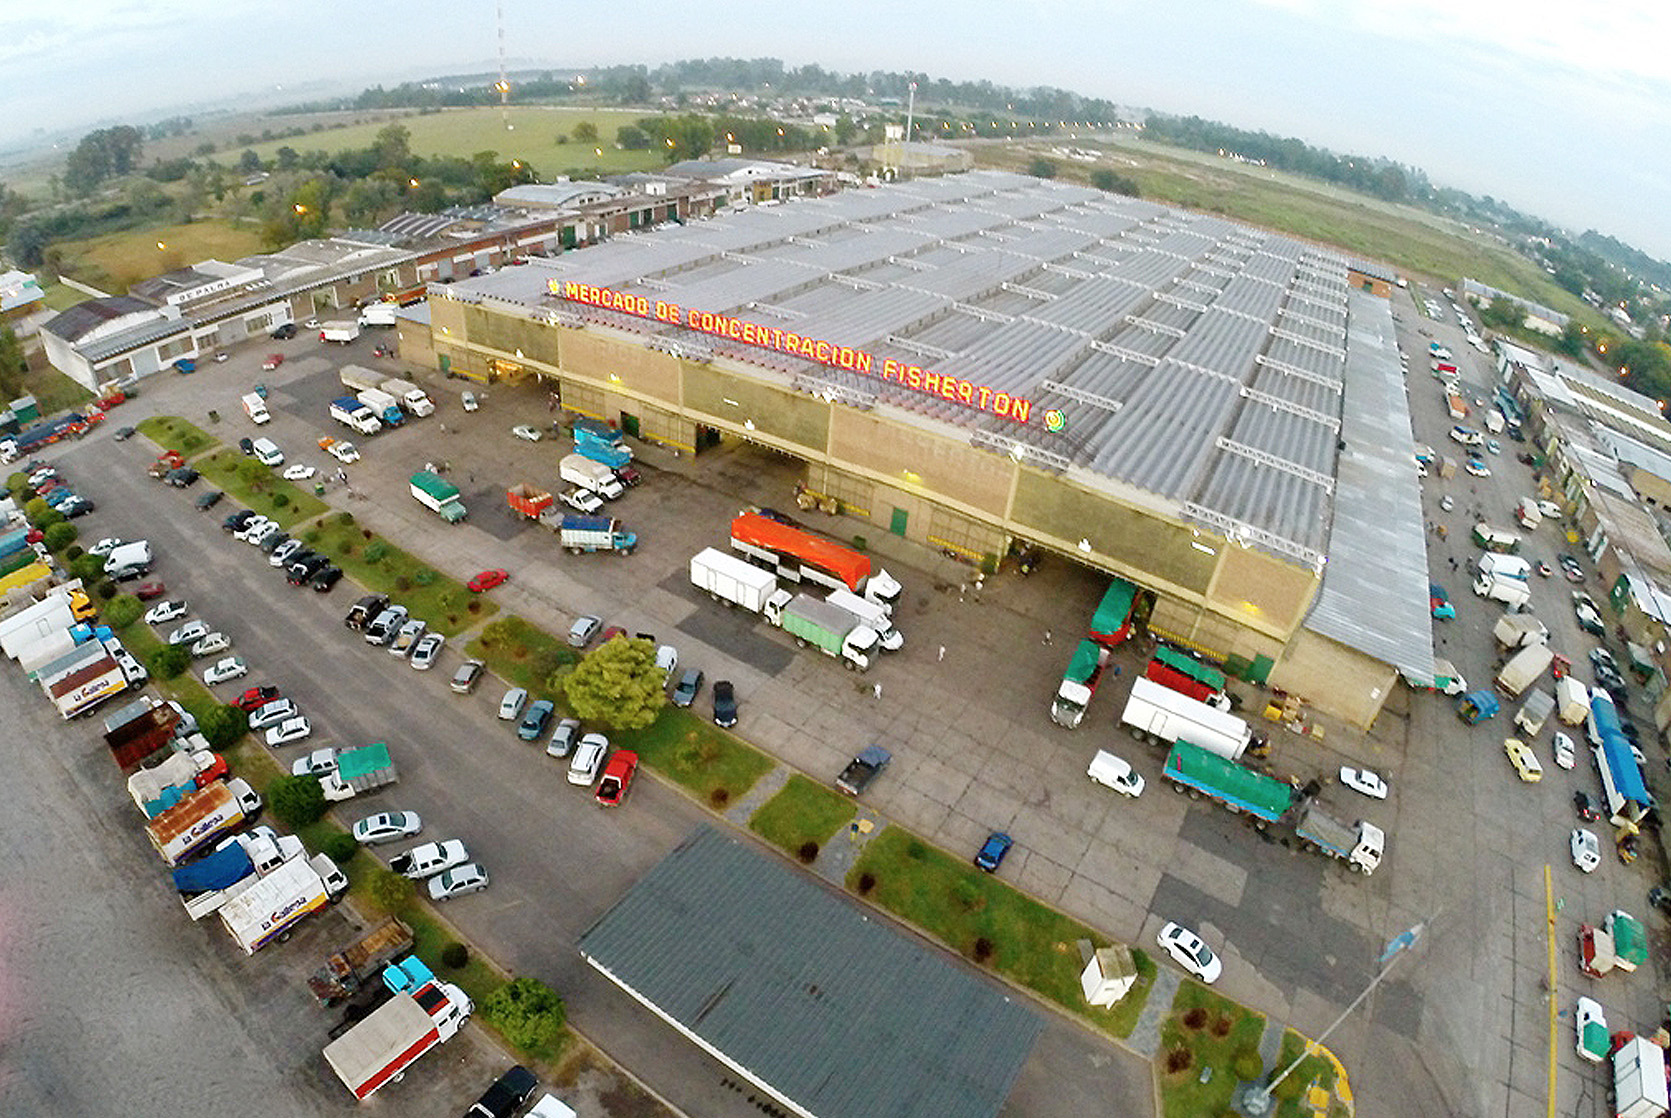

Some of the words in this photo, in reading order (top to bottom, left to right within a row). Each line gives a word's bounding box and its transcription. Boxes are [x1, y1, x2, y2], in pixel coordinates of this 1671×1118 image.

[565, 281, 649, 317] MERCADO
[655, 299, 682, 324] DE
[687, 307, 872, 374] CONCENTRACION
[883, 357, 1032, 422] FISHERTON
